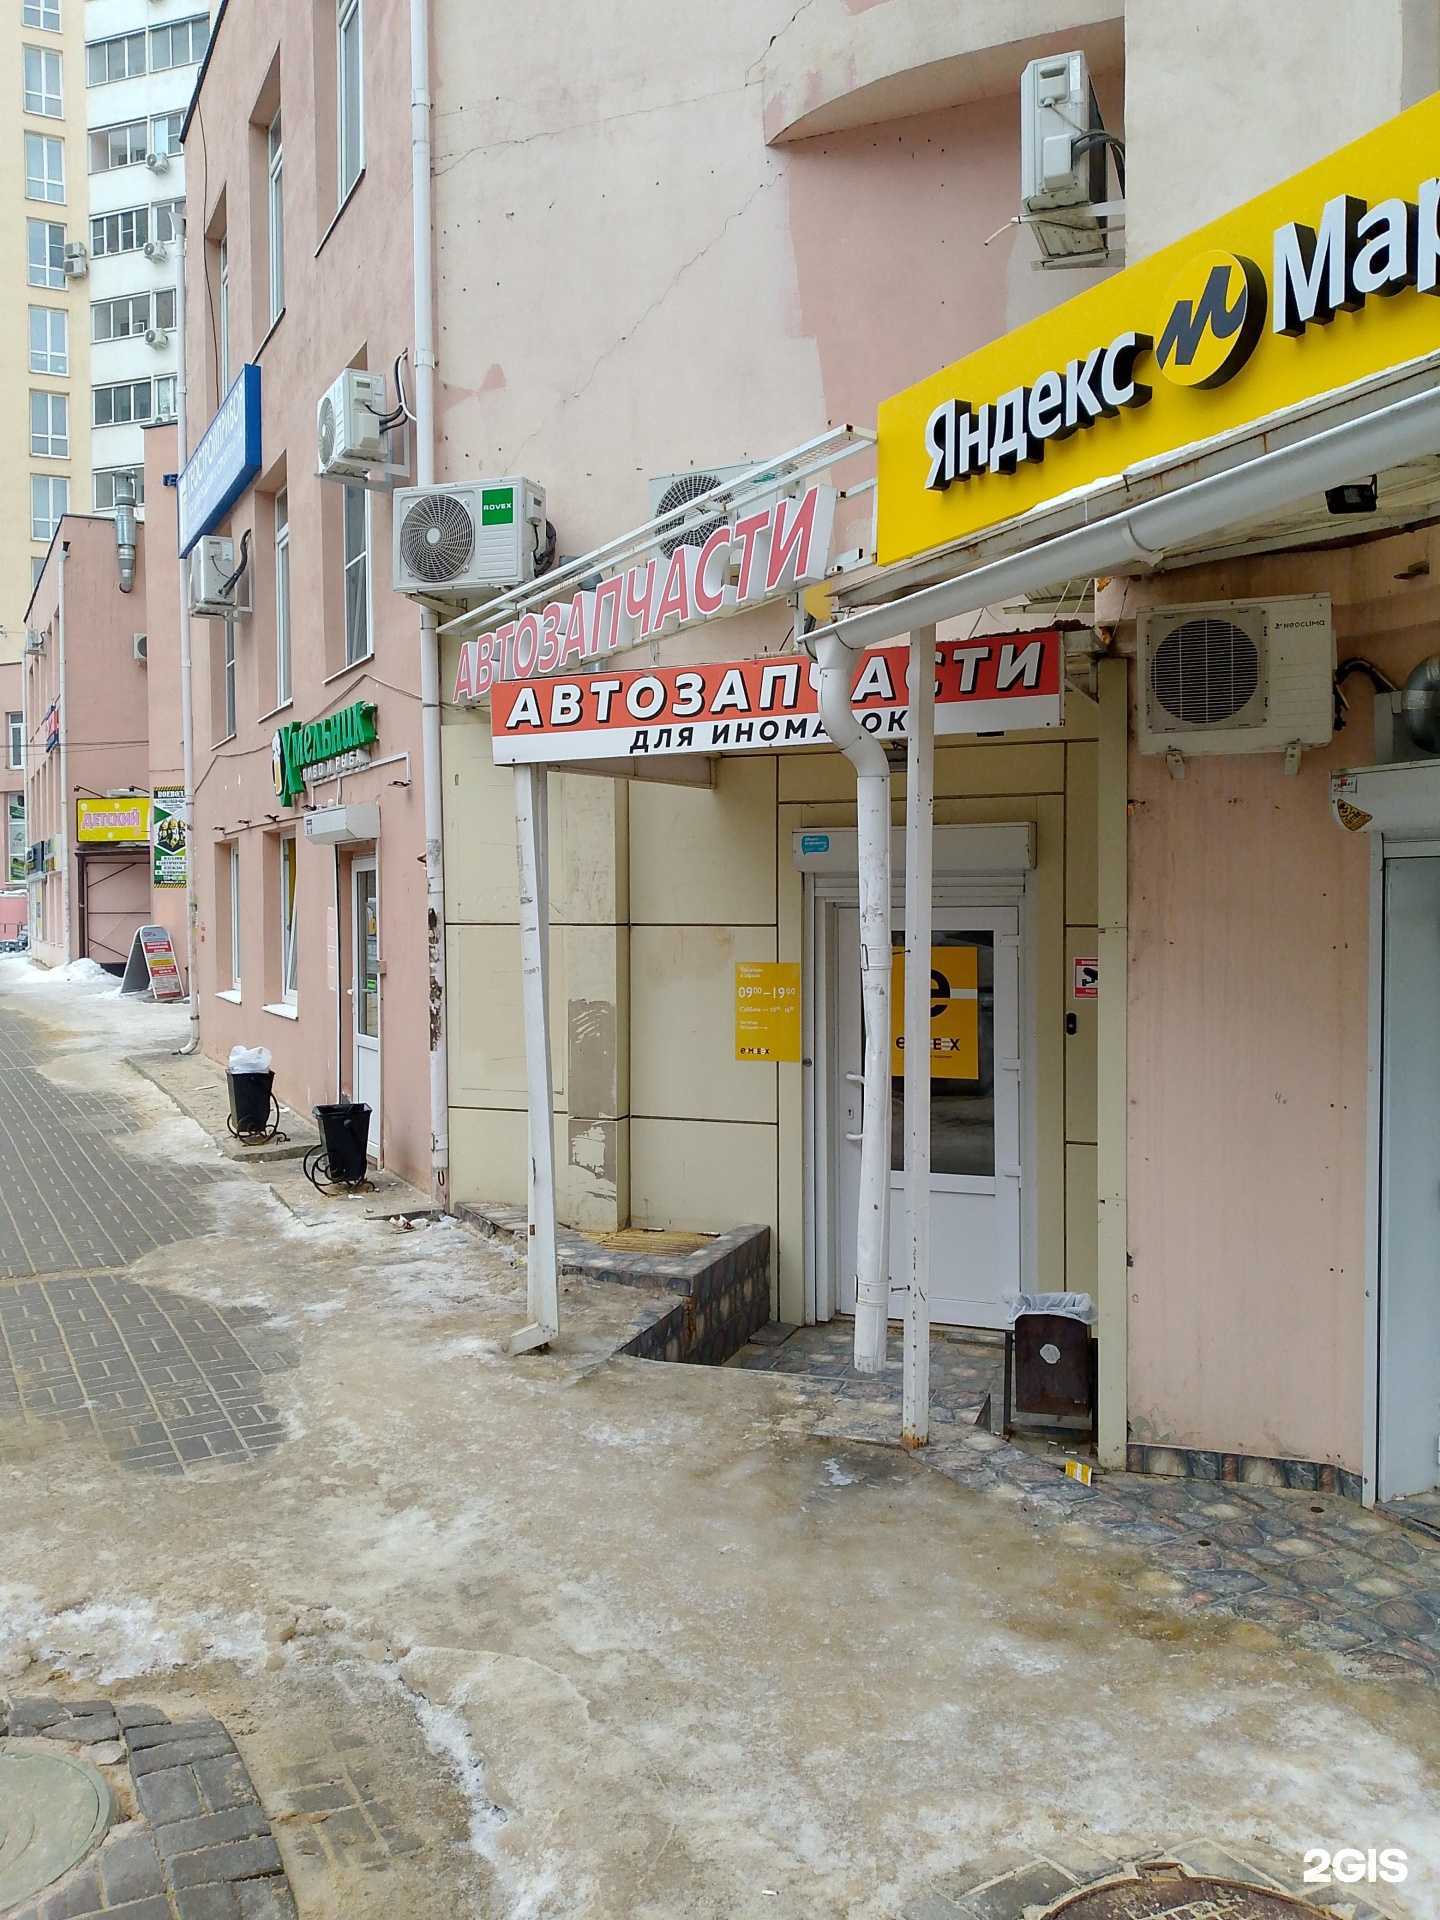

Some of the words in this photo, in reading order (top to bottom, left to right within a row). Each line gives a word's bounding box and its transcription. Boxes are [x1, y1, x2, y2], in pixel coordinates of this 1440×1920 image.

[924, 331, 1136, 490] Яндекс
[484, 503, 512, 511] ROVEX
[453, 485, 820, 705] АВТОЗАПЧАСТИ
[506, 641, 1042, 729] АВТОЗАПАТИ
[629, 727, 694, 754] ДЛЯ
[711, 710, 908, 745] ИНОМАОК
[302, 762, 327, 781] ПИВО
[81, 810, 139, 829] ДЕТСКИЙ
[896, 1037, 960, 1051] eEX
